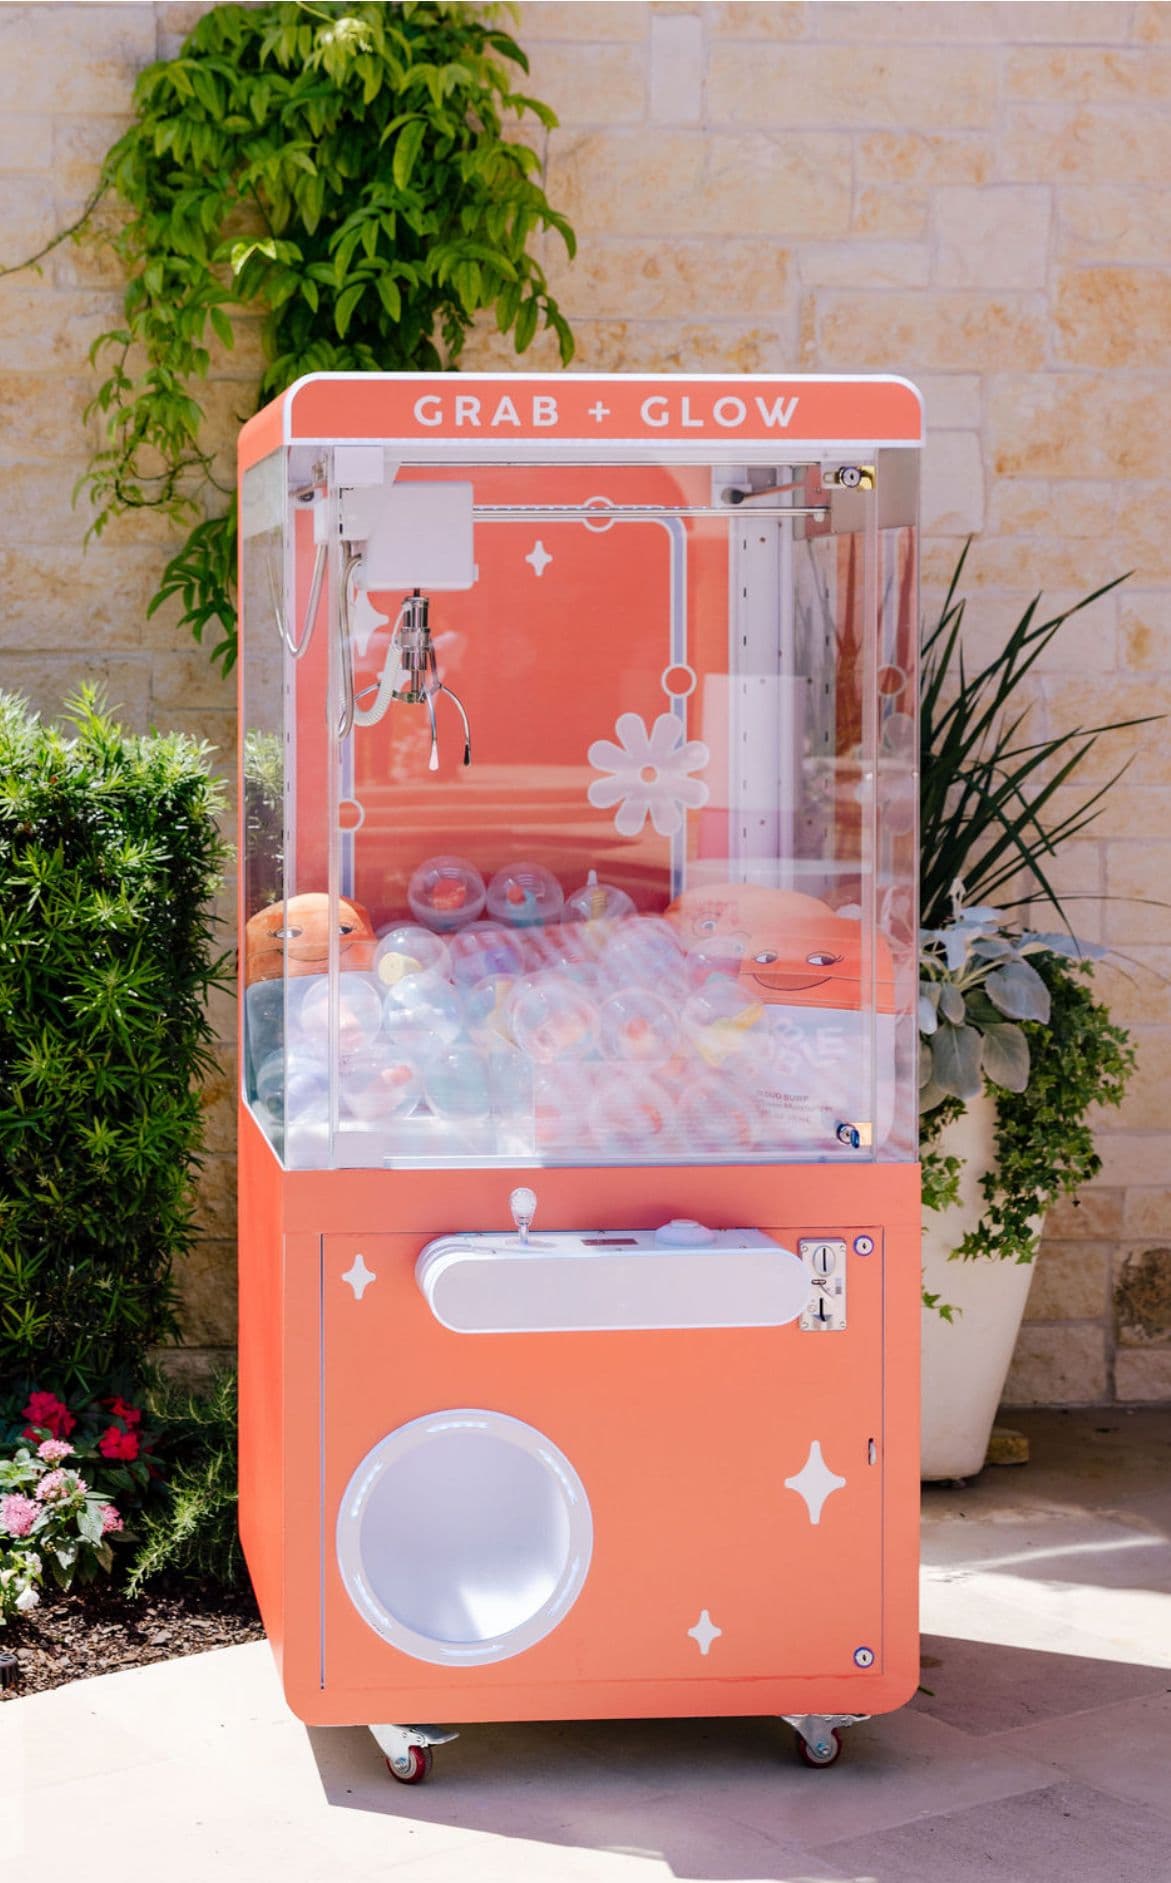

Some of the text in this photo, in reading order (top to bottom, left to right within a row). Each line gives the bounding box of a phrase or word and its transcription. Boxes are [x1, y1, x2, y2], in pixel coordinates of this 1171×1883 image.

[413, 394, 800, 428] GRAB + GLOW
